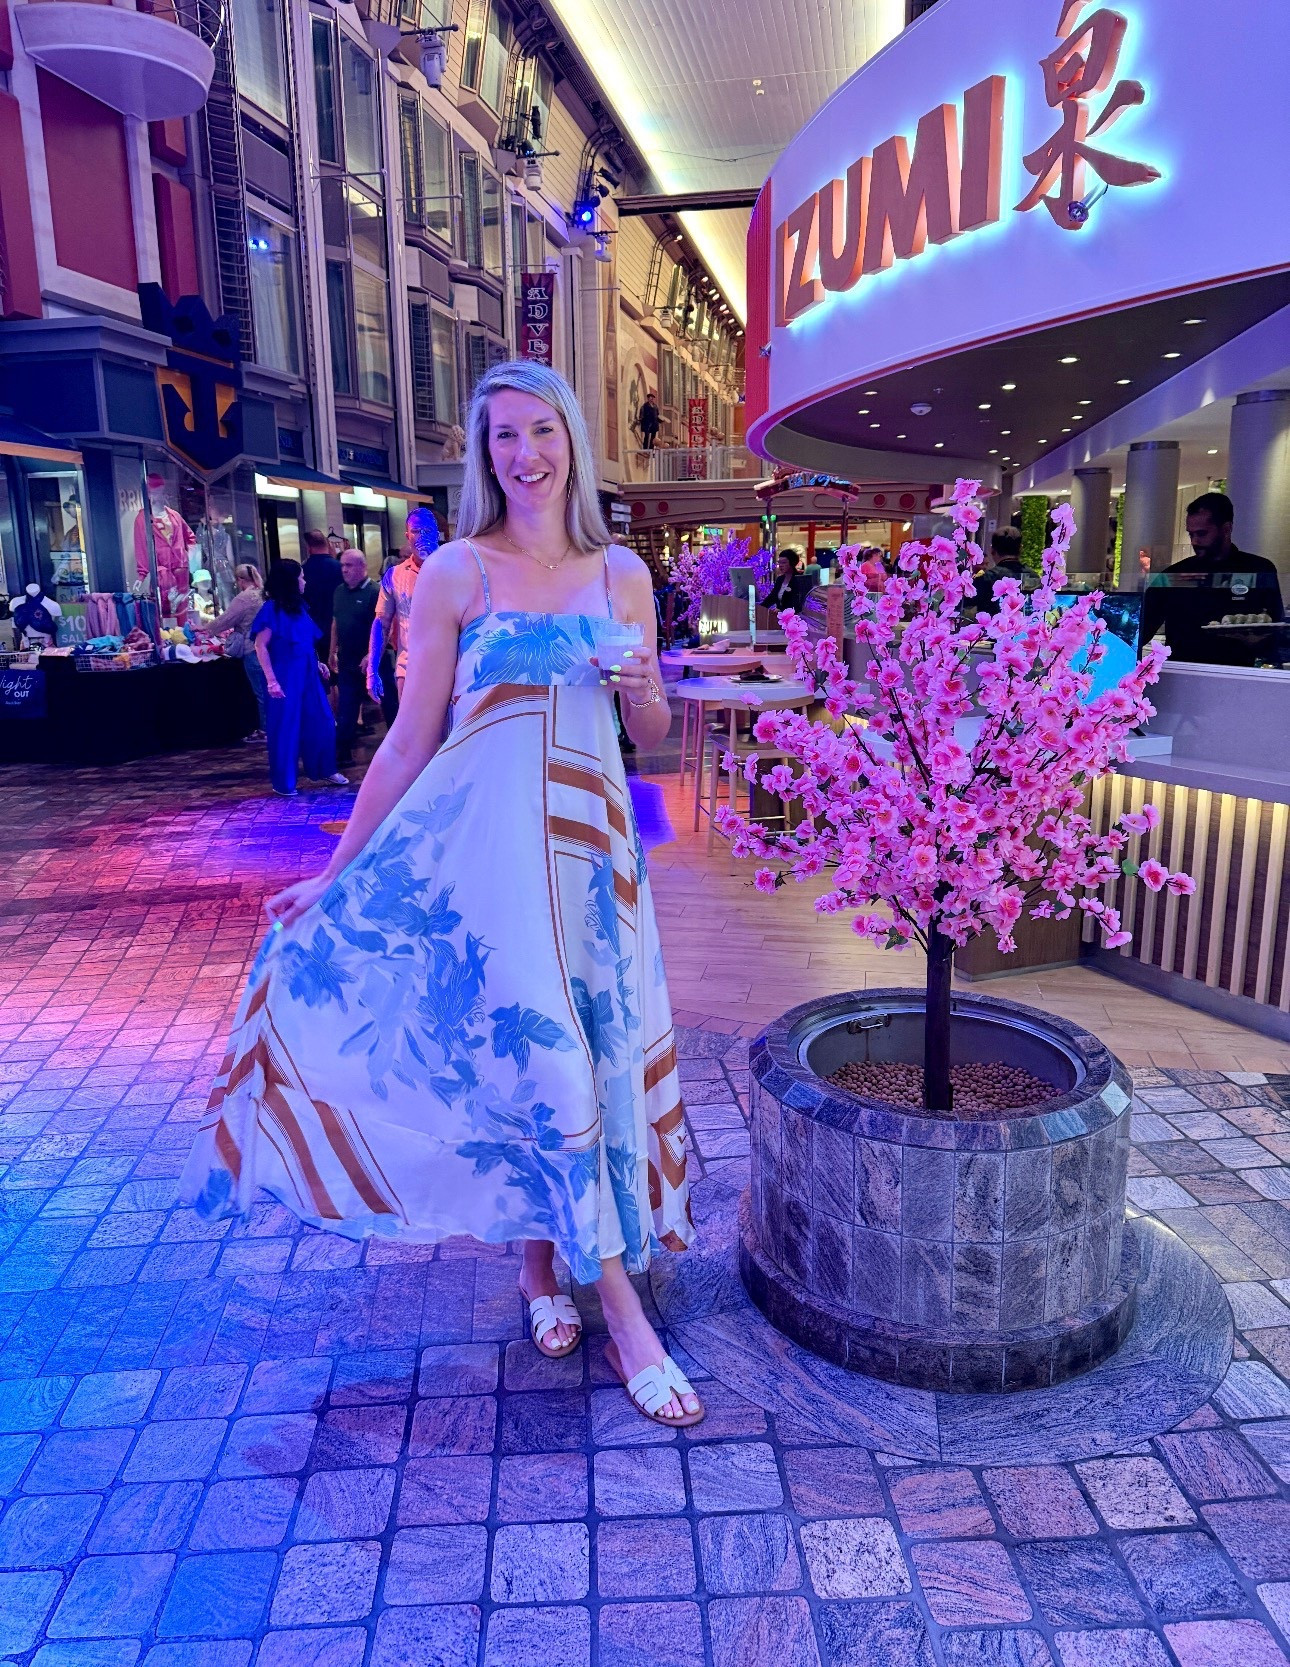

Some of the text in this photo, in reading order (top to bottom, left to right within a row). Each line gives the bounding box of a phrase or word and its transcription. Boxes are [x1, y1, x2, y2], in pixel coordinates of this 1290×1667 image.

[775, 75, 1006, 327] IZUMI
[58, 615, 87, 632] $10
[13, 690, 30, 698] OUT
